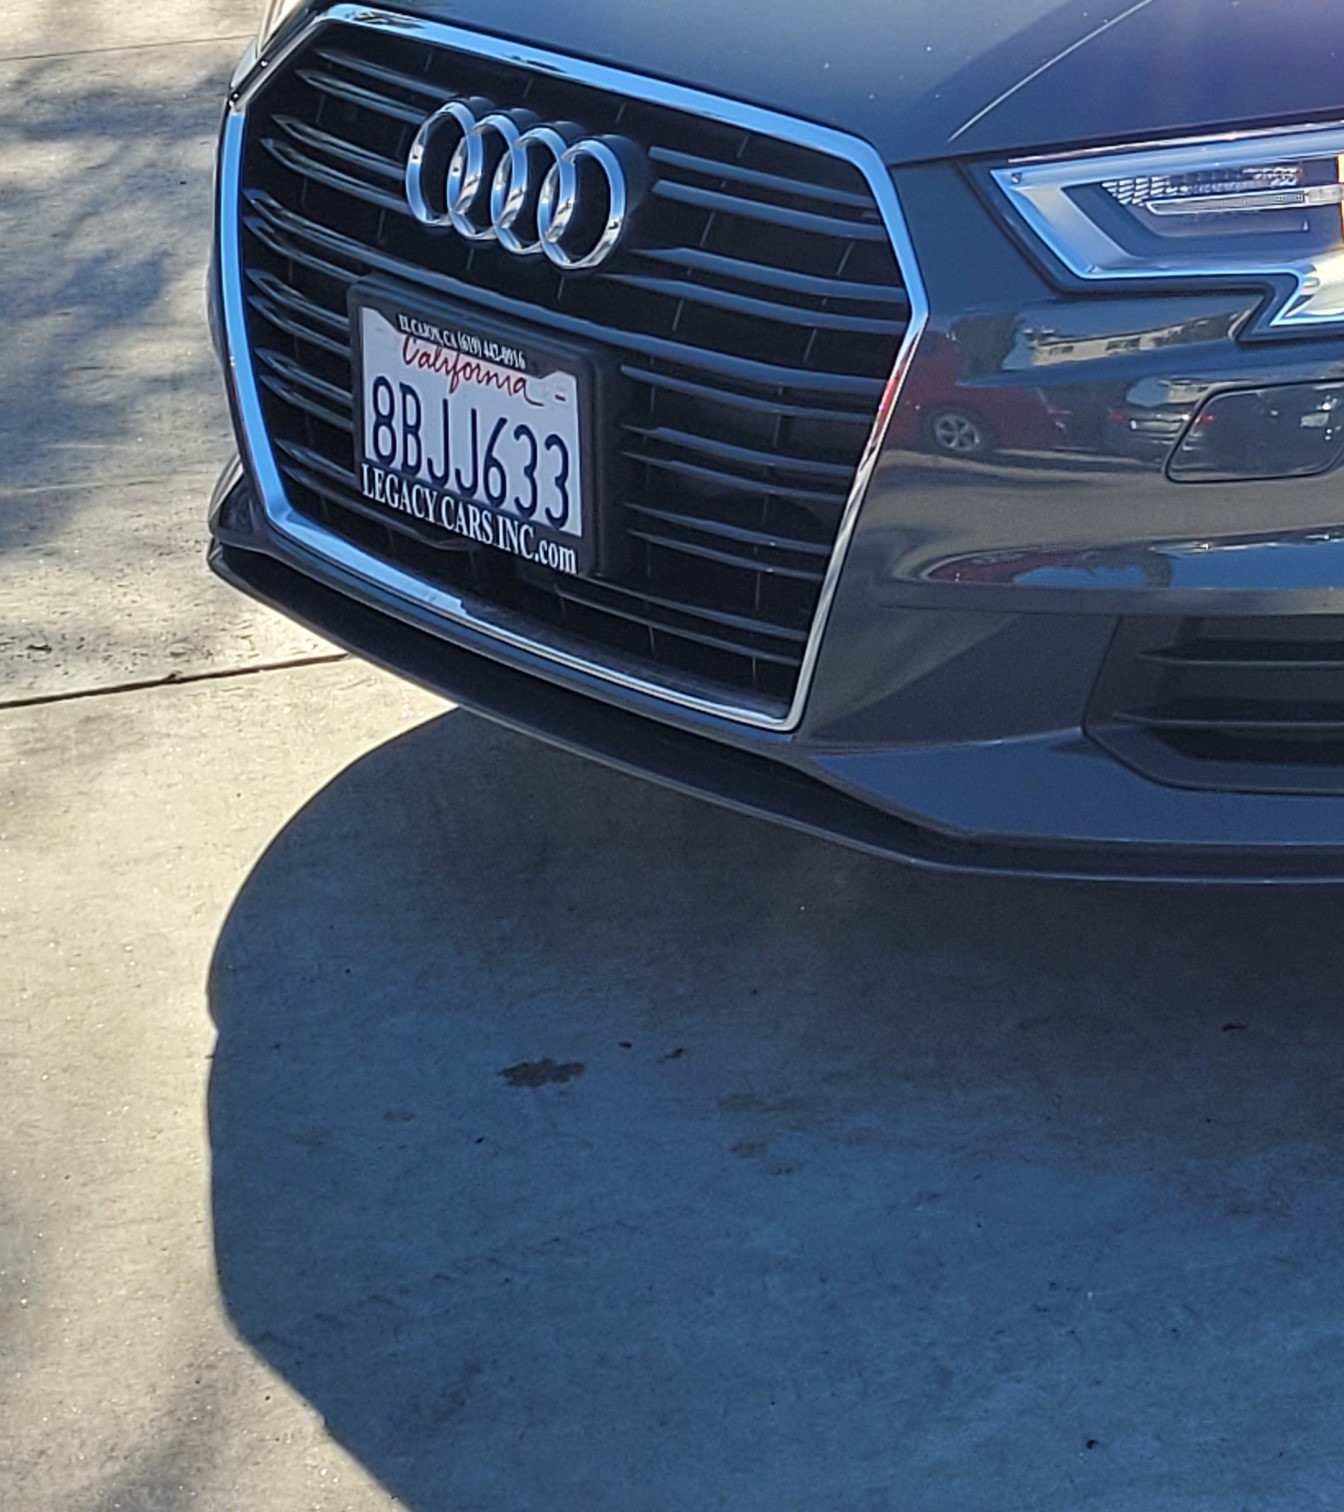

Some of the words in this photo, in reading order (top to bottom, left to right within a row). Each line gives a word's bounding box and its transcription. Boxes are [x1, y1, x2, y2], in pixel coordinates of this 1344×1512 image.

[402, 335, 543, 406] California
[372, 376, 570, 530] 8BJJ633
[361, 463, 438, 524] LEGACY
[441, 496, 494, 545] CARS
[496, 514, 577, 574] INC.com
